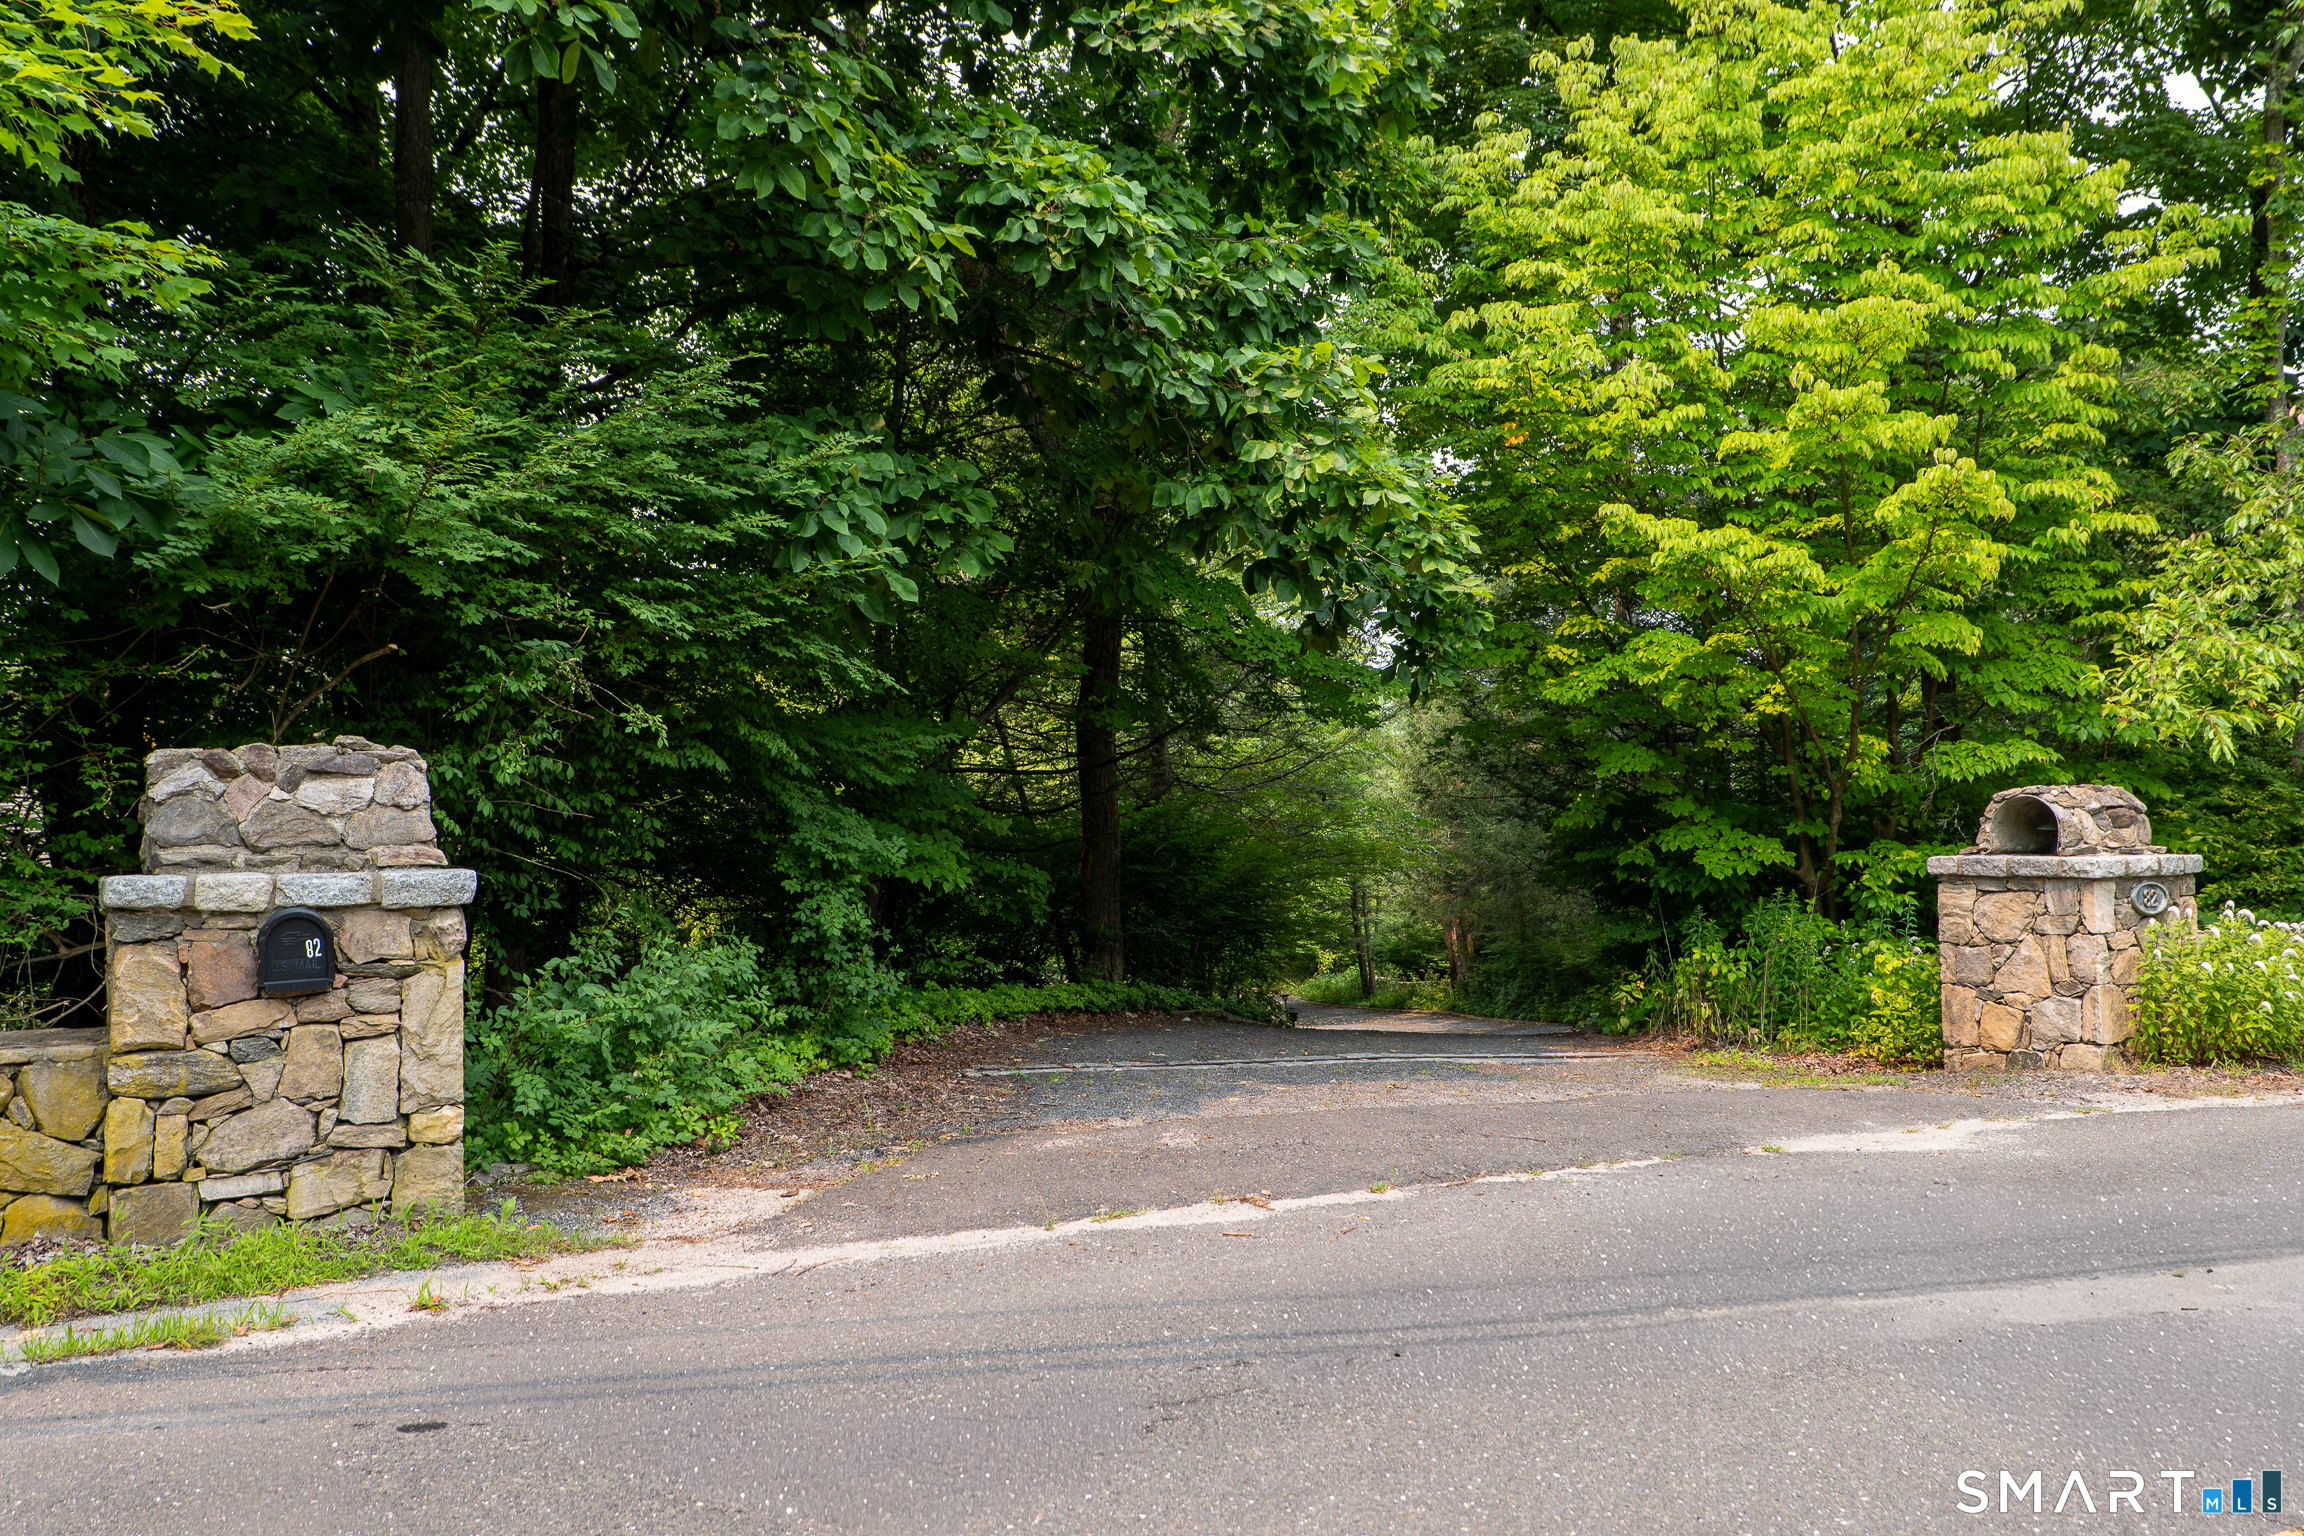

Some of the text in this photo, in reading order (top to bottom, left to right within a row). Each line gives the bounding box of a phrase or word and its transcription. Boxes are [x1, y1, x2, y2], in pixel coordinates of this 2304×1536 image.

[2143, 889, 2158, 908] 82
[305, 938, 322, 958] 82
[271, 960, 322, 972] U.S. MAIL
